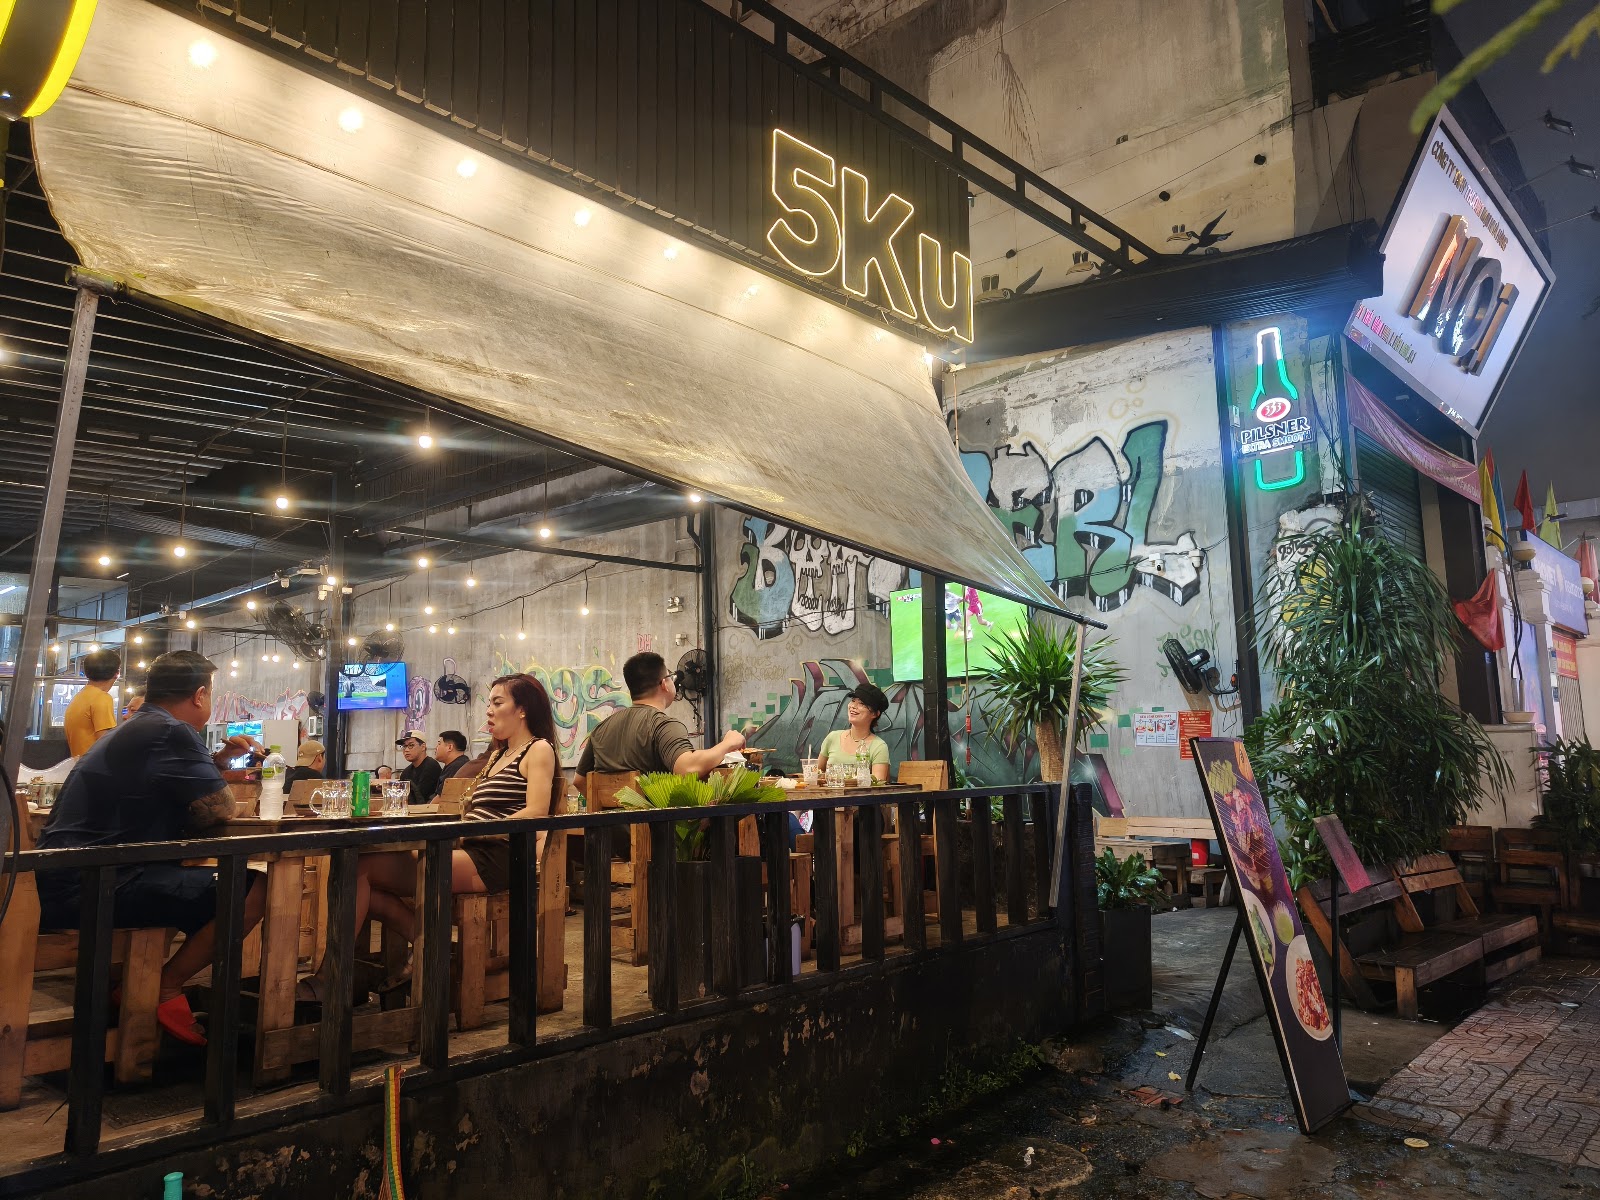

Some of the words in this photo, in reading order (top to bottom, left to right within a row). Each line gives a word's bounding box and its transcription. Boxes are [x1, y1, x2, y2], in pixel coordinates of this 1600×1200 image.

[1431, 140, 1449, 170] CÔNG
[1446, 159, 1456, 178] TY
[1241, 416, 1311, 444] PILSNER
[1242, 438, 1272, 454] EXTRA
[1272, 430, 1312, 448] SMOOTH
